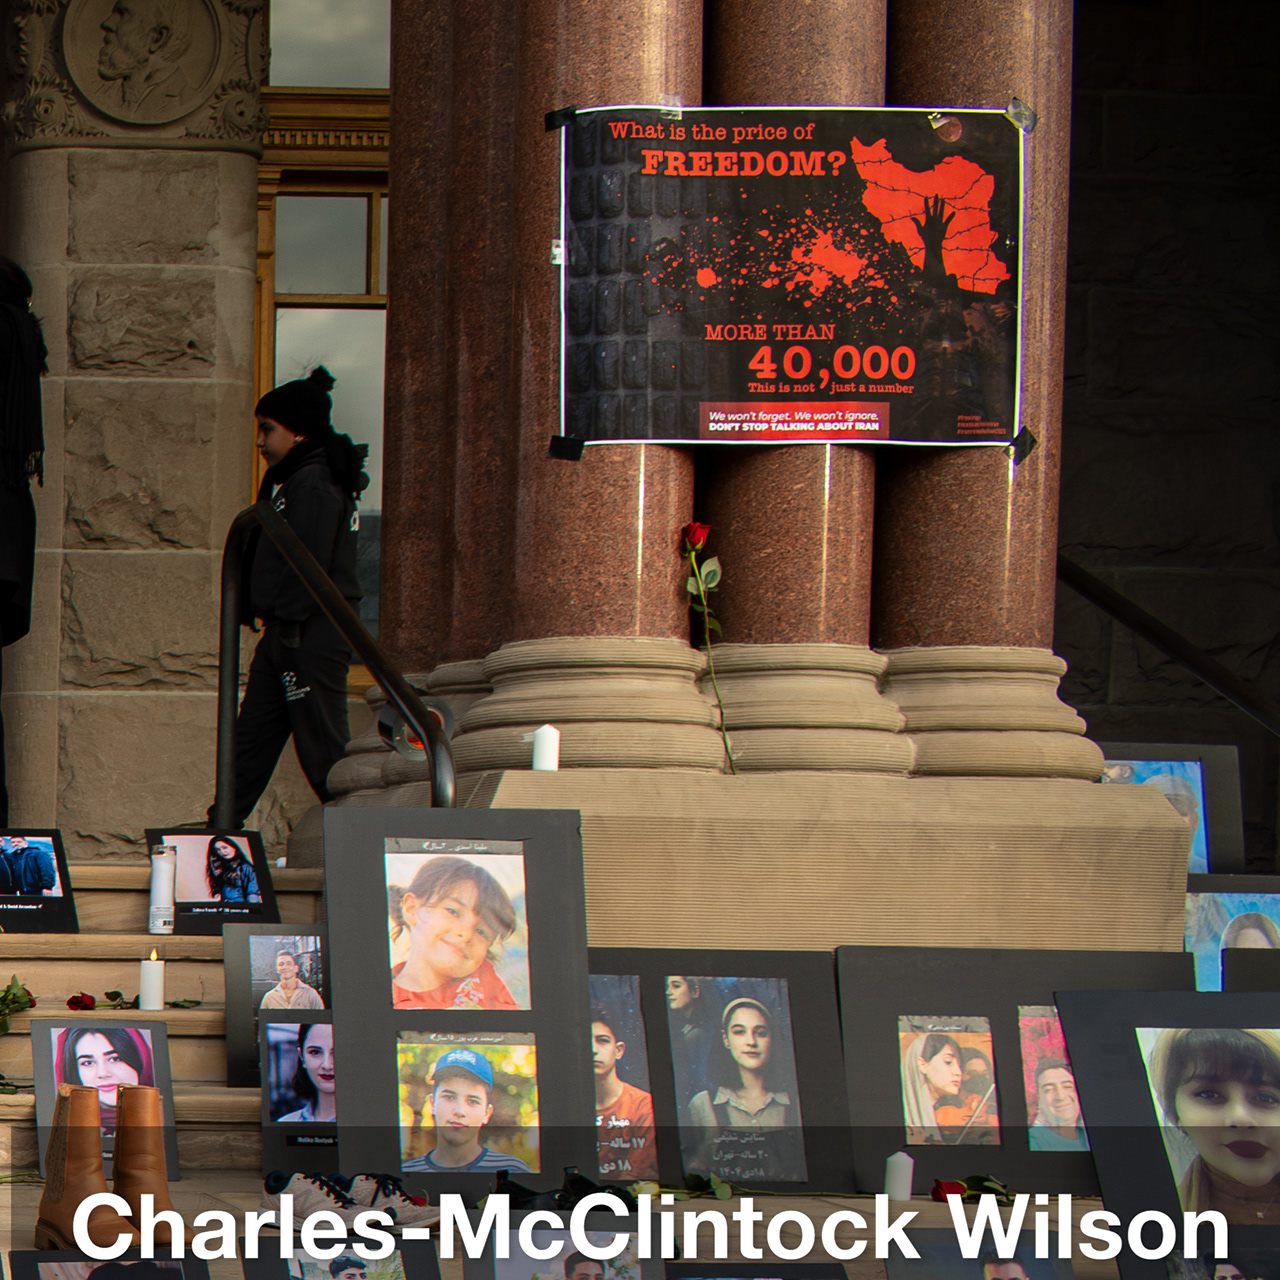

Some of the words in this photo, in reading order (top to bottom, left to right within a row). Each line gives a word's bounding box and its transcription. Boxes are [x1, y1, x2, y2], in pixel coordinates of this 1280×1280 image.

[609, 122, 665, 139] What
[670, 124, 686, 140] is
[692, 124, 726, 140] the
[733, 124, 786, 143] price
[793, 123, 816, 140] of
[642, 150, 846, 176] FREEDOM?
[705, 325, 767, 340] MORE
[773, 324, 835, 340] THAN
[748, 345, 916, 389] 40,000
[748, 383, 775, 392] This
[779, 382, 790, 392] is
[794, 383, 815, 392] not
[830, 382, 855, 394] just
[869, 383, 914, 393] number
